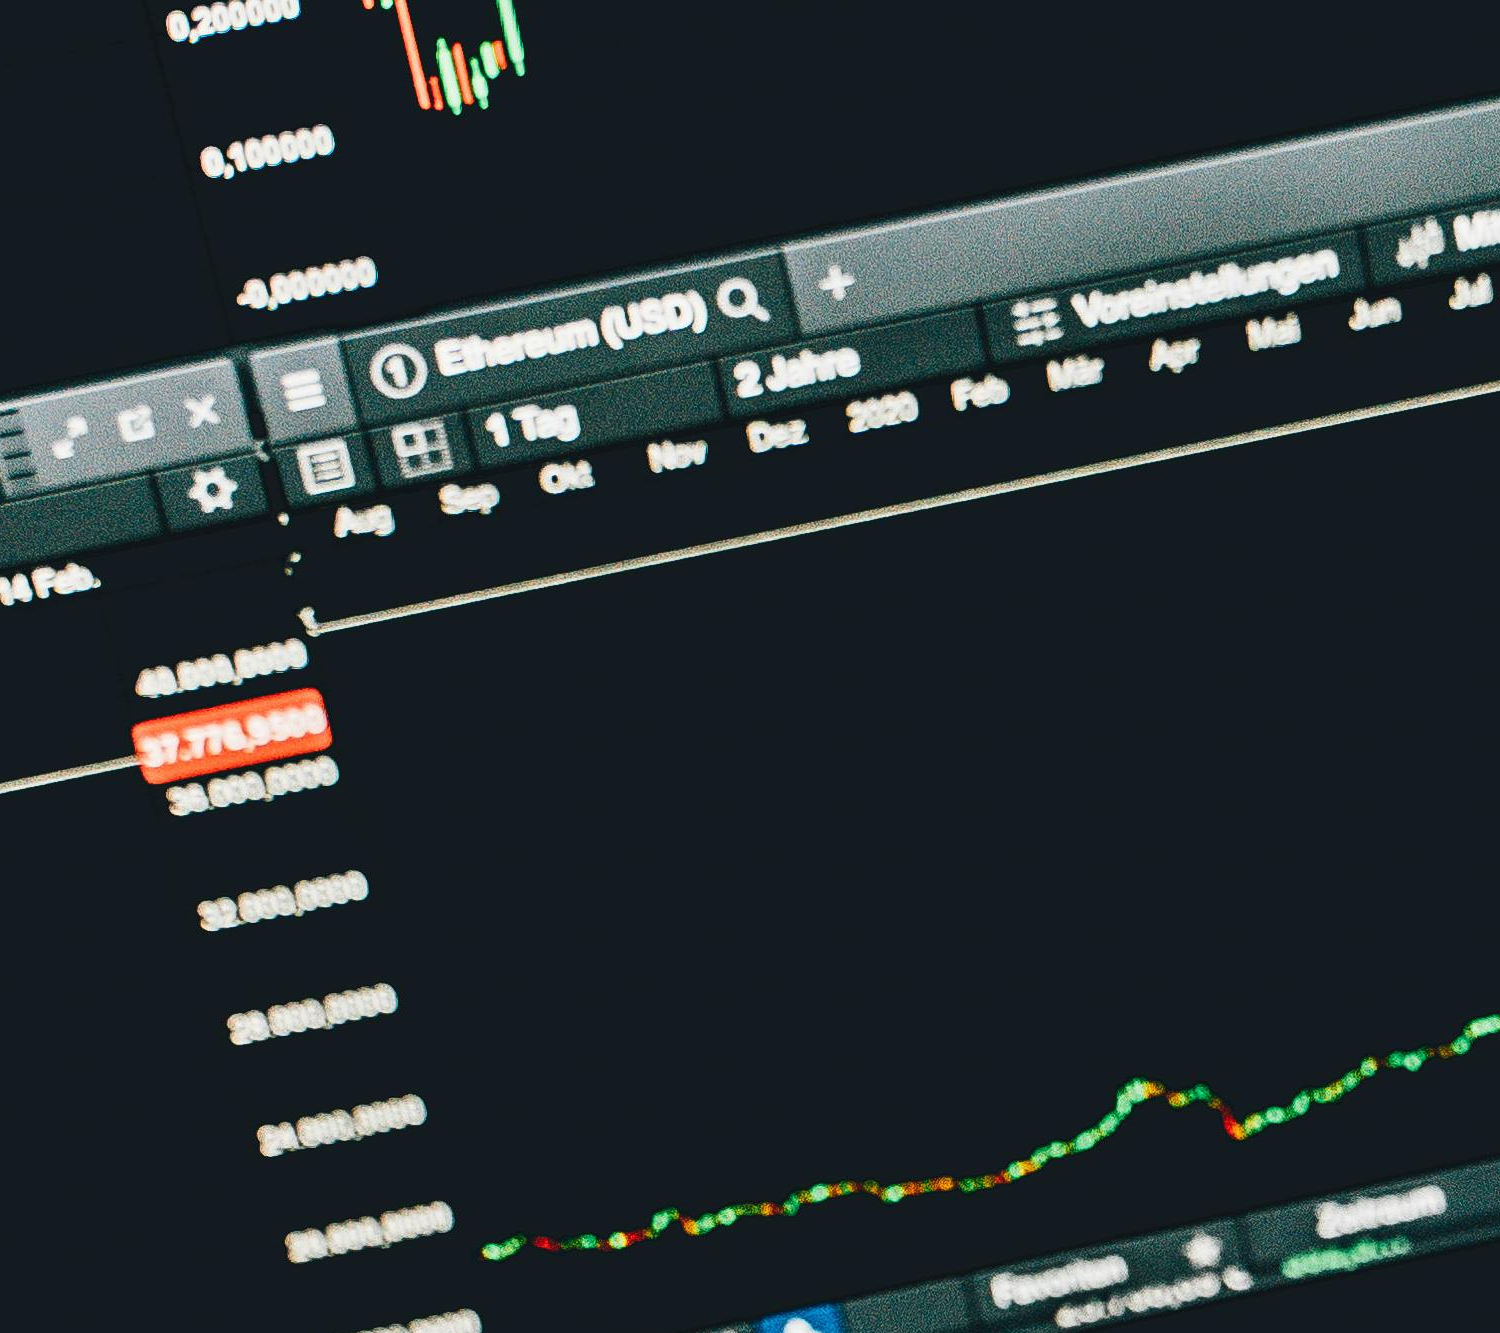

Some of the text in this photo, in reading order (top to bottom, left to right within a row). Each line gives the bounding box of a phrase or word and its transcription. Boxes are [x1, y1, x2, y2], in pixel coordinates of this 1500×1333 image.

[433, 289, 708, 377] Ethereum (USD)
[765, 347, 861, 392] Jahre
